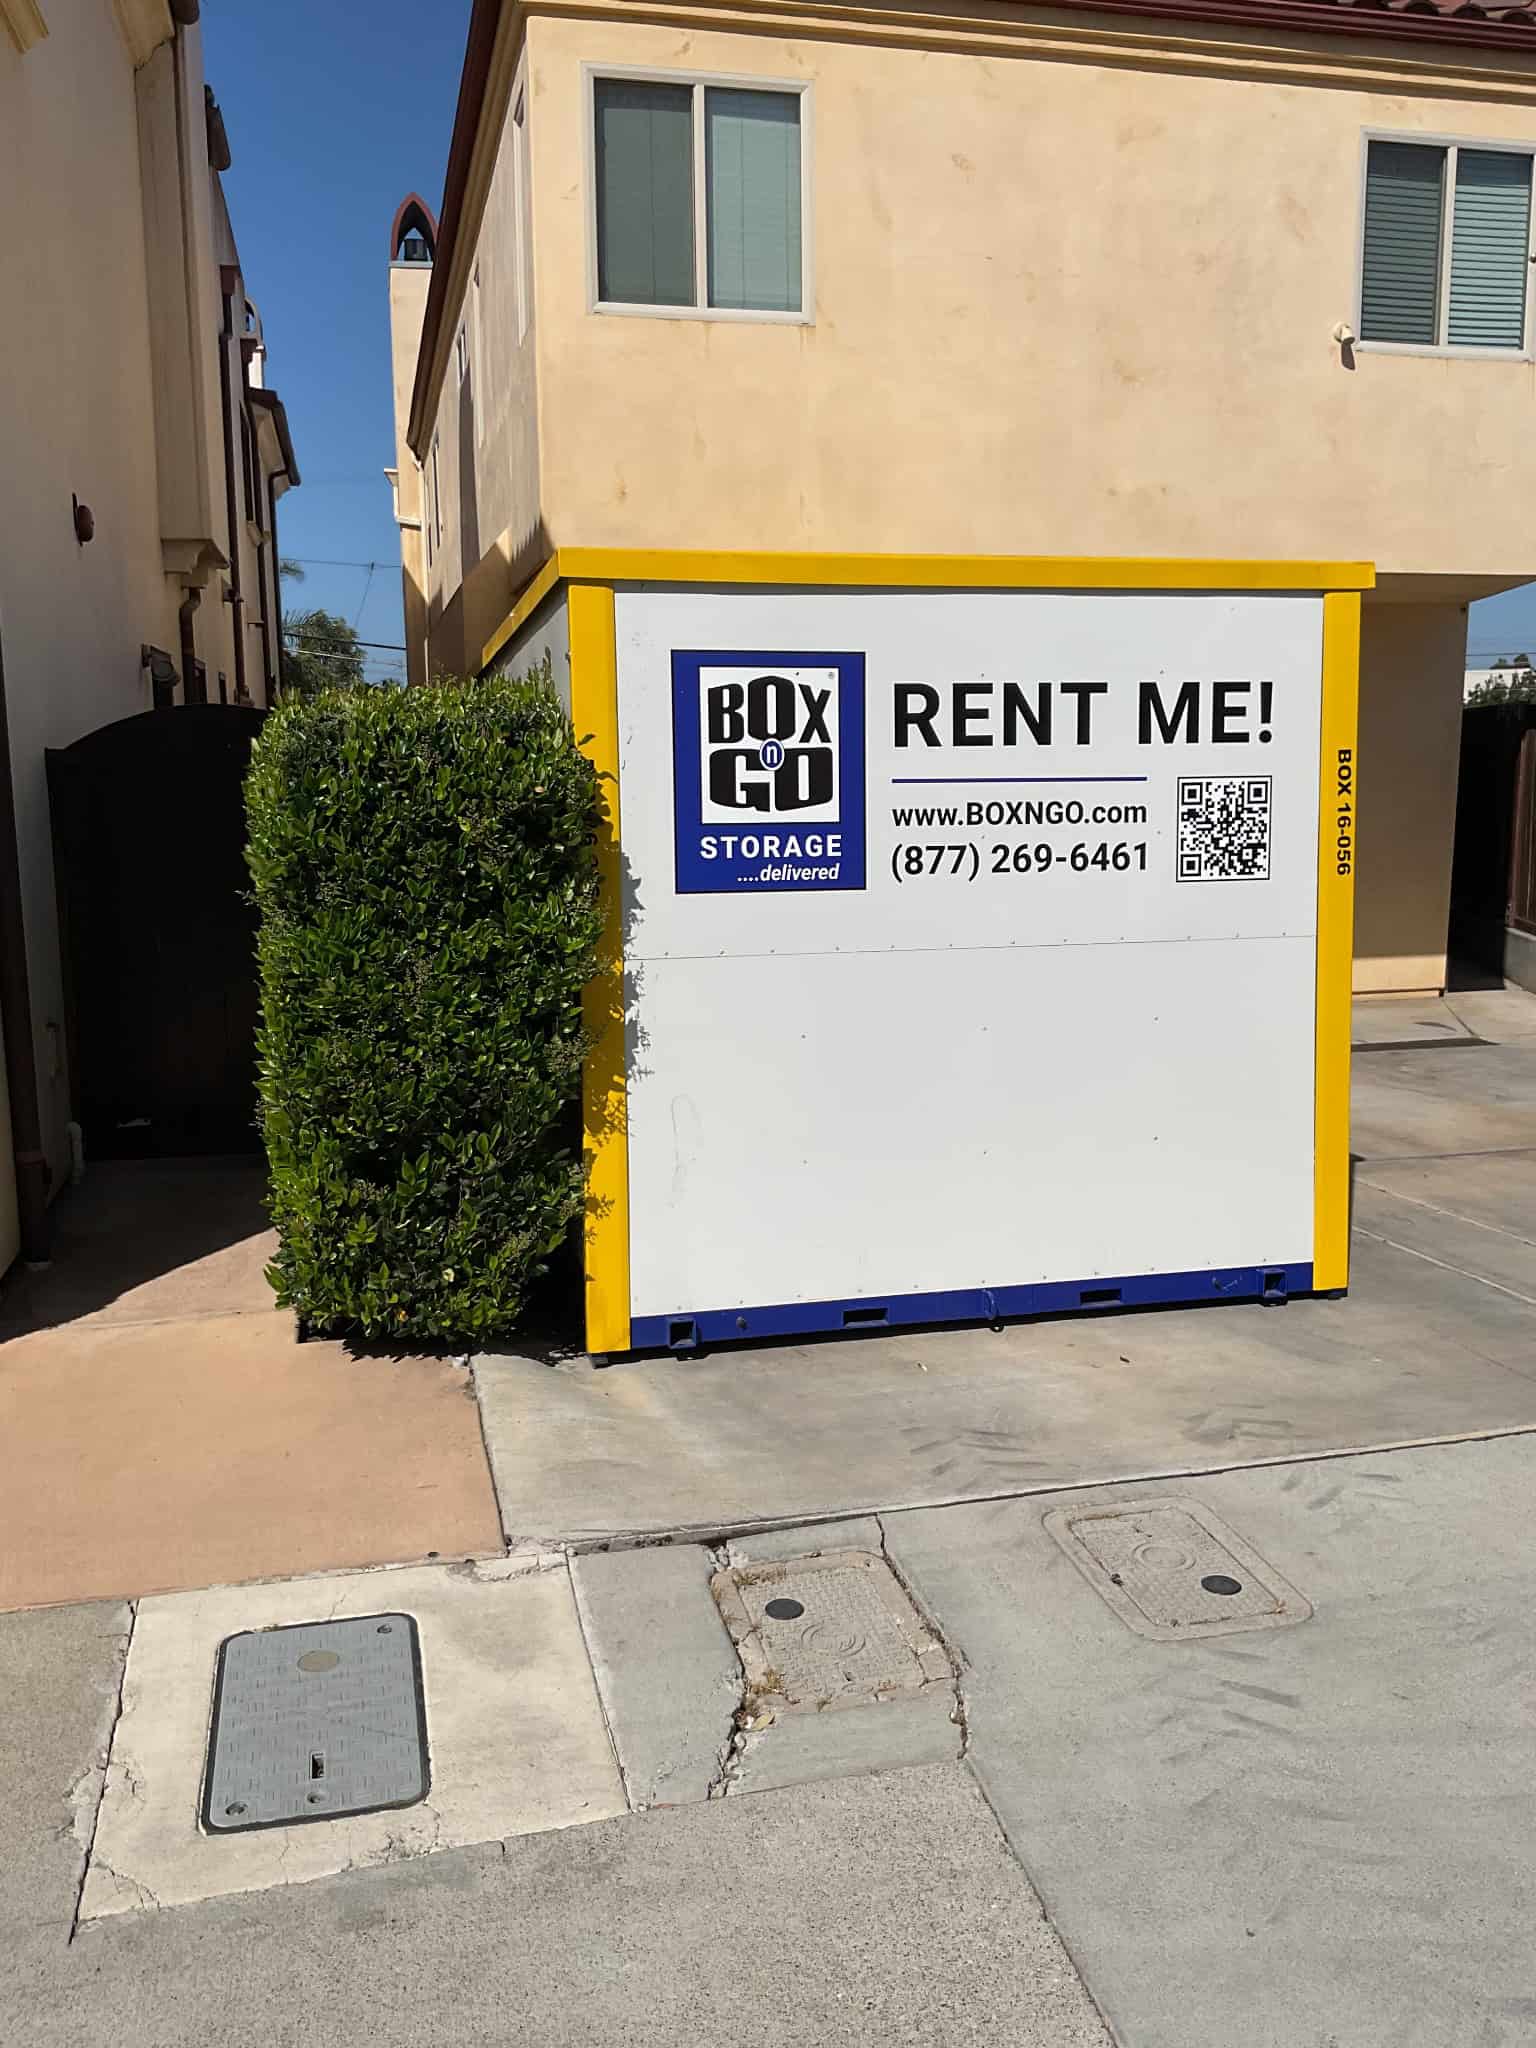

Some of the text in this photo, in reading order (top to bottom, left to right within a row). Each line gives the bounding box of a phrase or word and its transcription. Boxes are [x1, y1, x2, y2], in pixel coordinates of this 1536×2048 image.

[707, 675, 832, 744] BOX
[893, 681, 1273, 747] RENT ME!
[709, 747, 833, 812] GO
[766, 745, 778, 765] n
[891, 800, 1148, 827] www.BOXNGO.com
[1335, 748, 1352, 875] BOX 16-056
[700, 834, 842, 859] STORAGE
[890, 841, 1148, 883] (877) 269-6461
